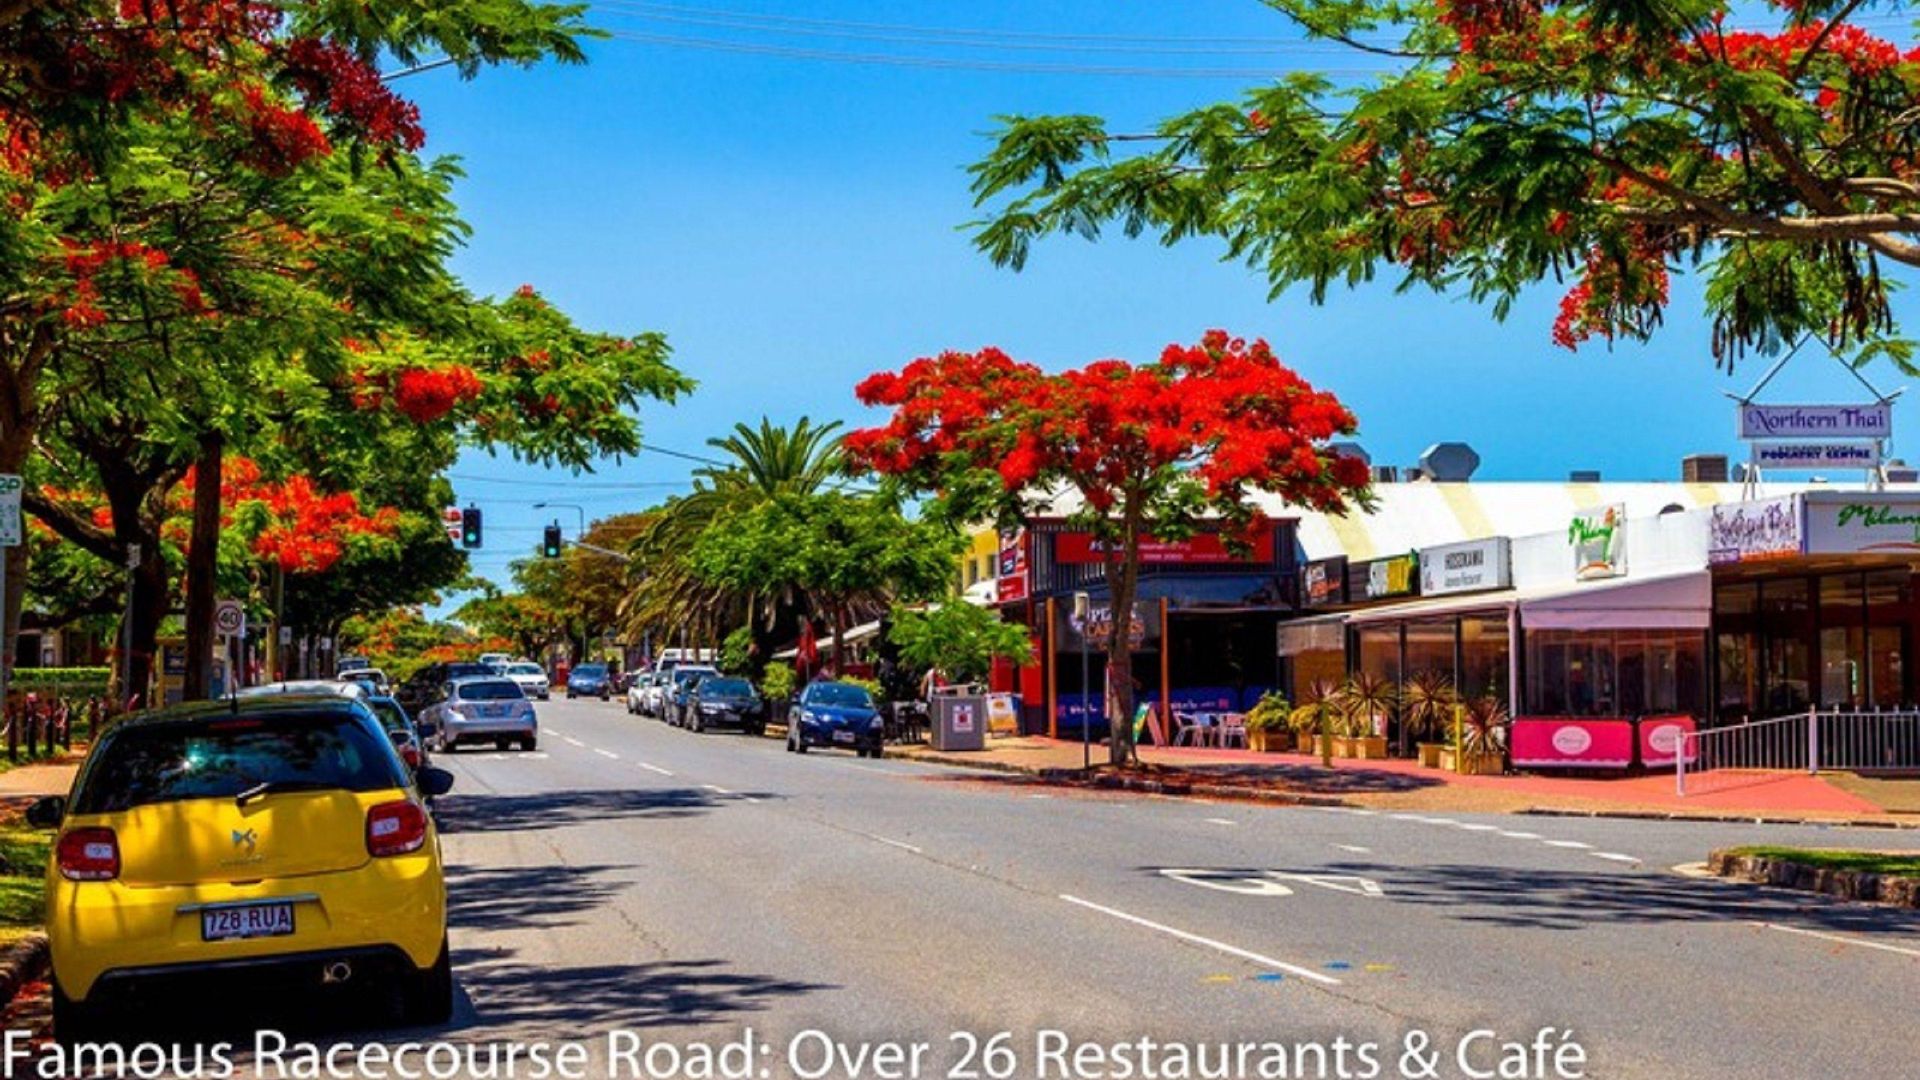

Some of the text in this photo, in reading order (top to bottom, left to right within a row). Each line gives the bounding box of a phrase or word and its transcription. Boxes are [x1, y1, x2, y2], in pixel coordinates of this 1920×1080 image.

[1747, 408, 1884, 434] Northern Thai
[221, 610, 238, 625] 40
